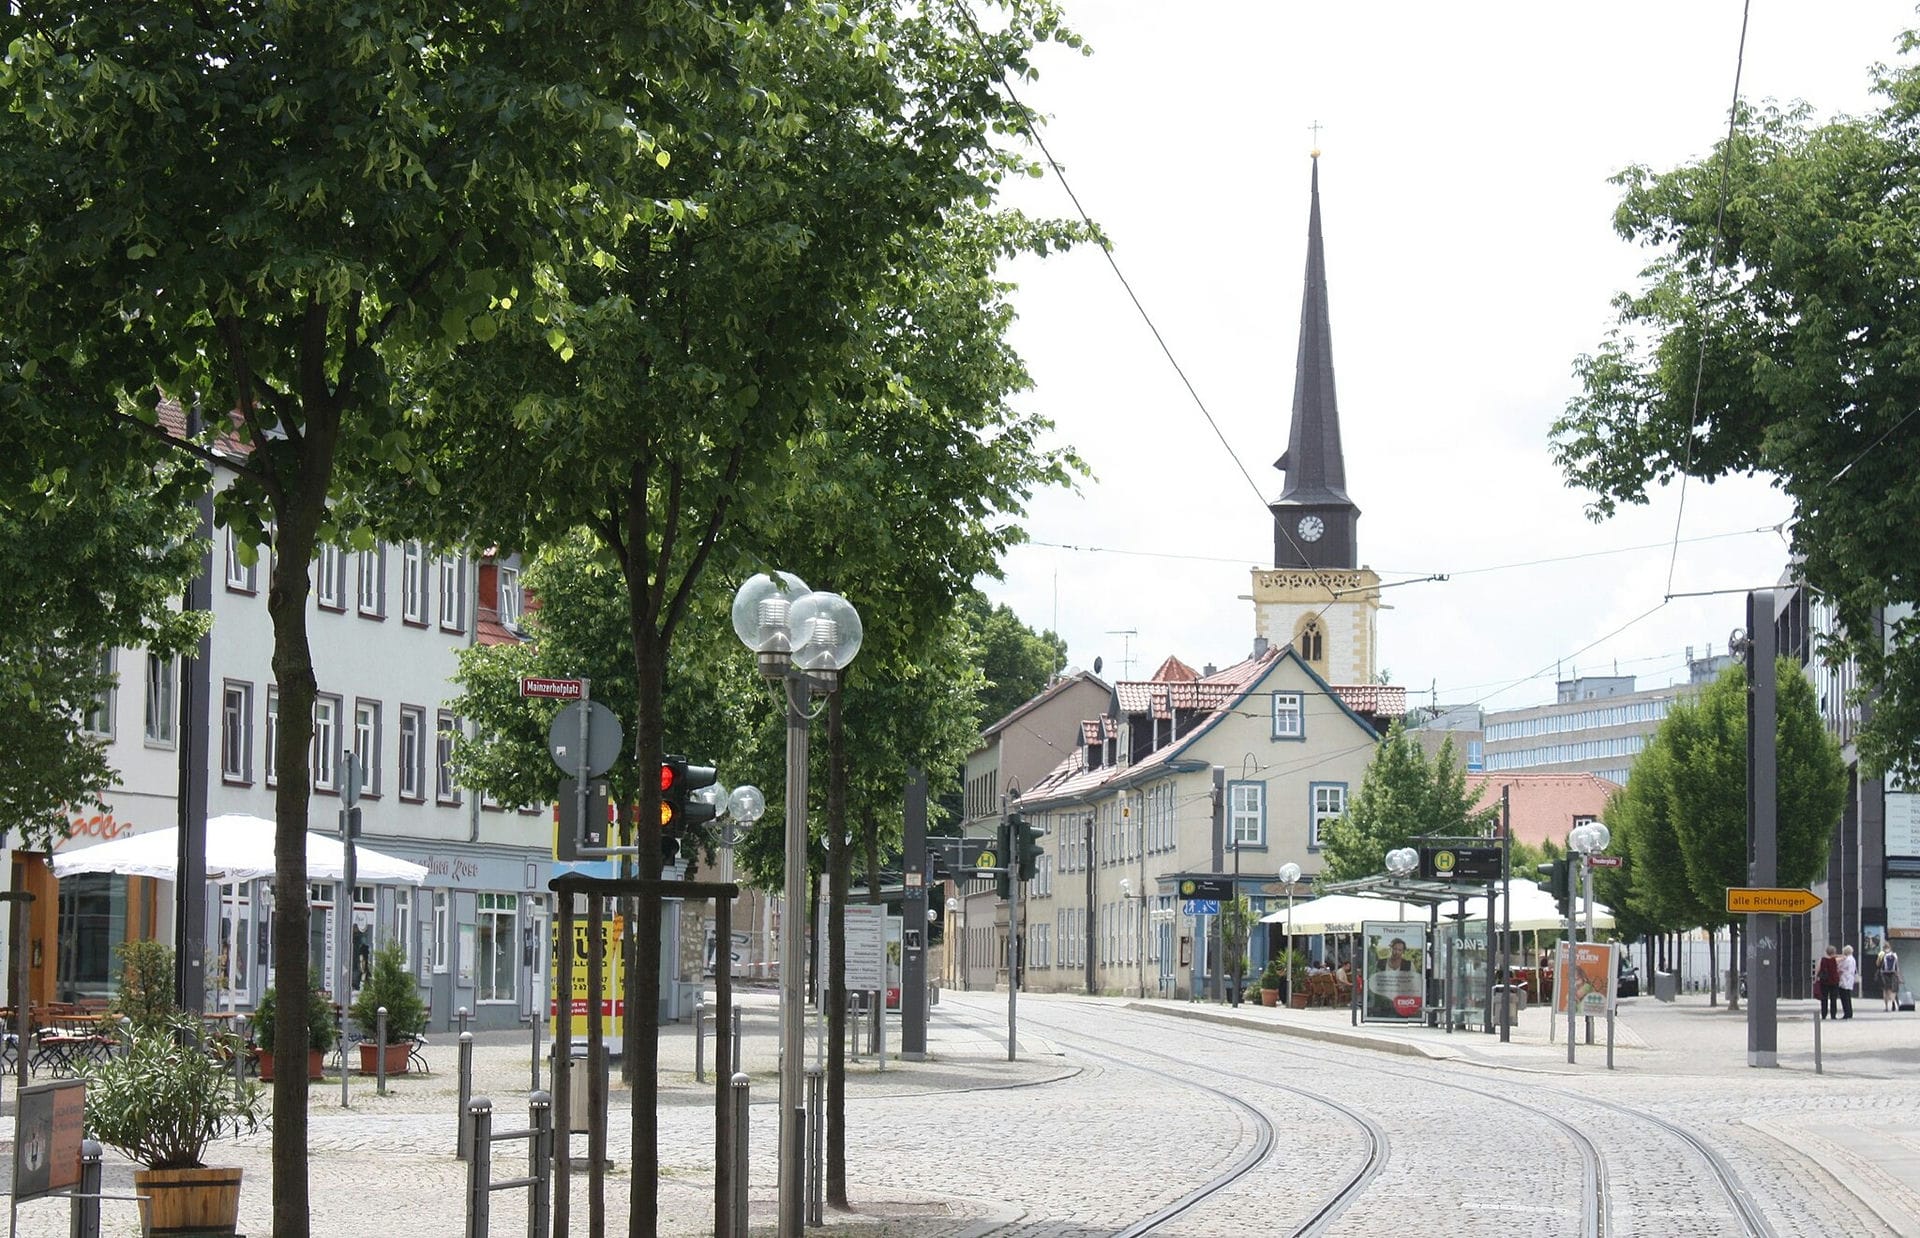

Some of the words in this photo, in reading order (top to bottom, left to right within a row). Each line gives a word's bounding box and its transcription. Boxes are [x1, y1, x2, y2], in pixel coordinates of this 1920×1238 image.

[527, 680, 579, 696] Mainzerhofplatz
[1440, 855, 1450, 867] H
[1733, 896, 1750, 905] alle
[1753, 896, 1806, 908] Richtungen
